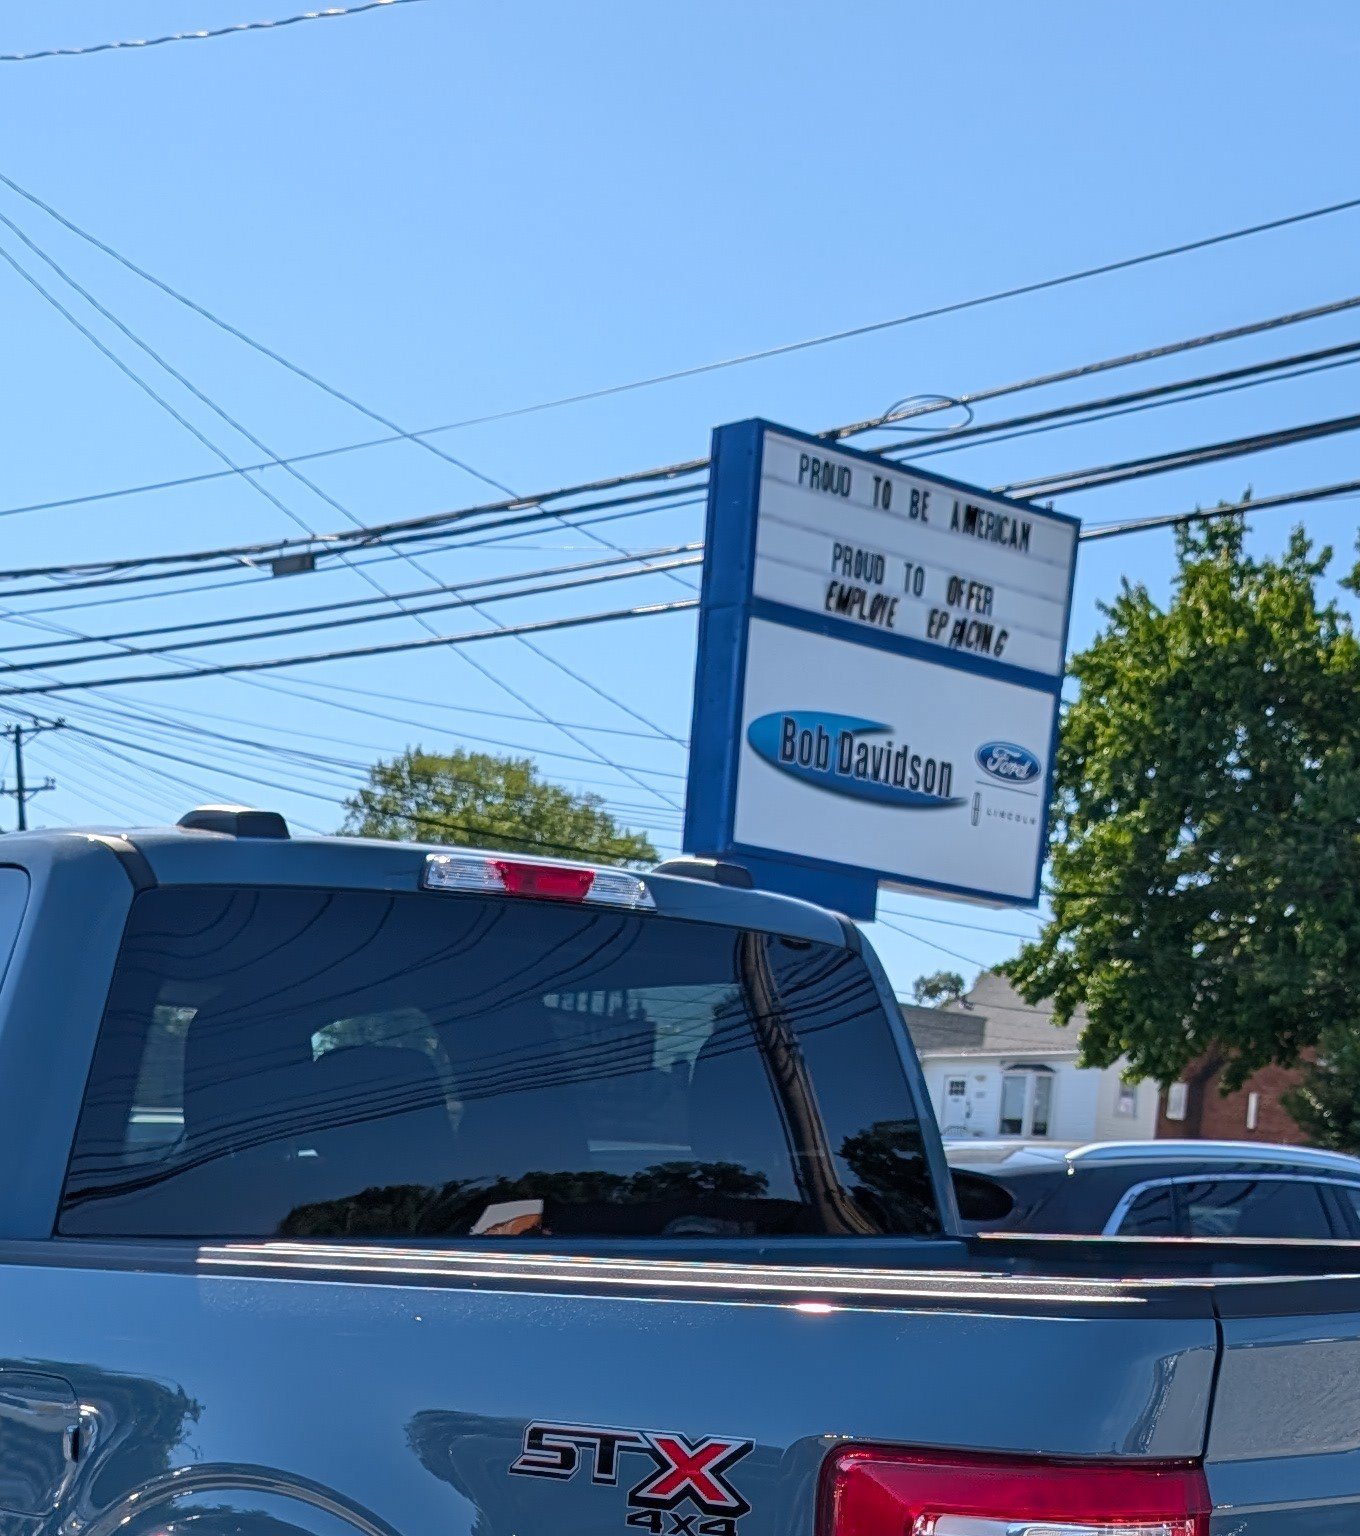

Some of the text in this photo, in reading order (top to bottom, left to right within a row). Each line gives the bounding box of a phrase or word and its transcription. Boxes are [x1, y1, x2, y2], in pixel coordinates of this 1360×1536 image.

[798, 453, 1032, 553] PROUD TO BE AMERICAN
[831, 542, 995, 617] PROUD TO OFFER
[781, 716, 953, 798] Bob Davidson
[983, 745, 1034, 780] Ford
[987, 808, 1036, 825] LINCOLN
[508, 1419, 756, 1519] STX
